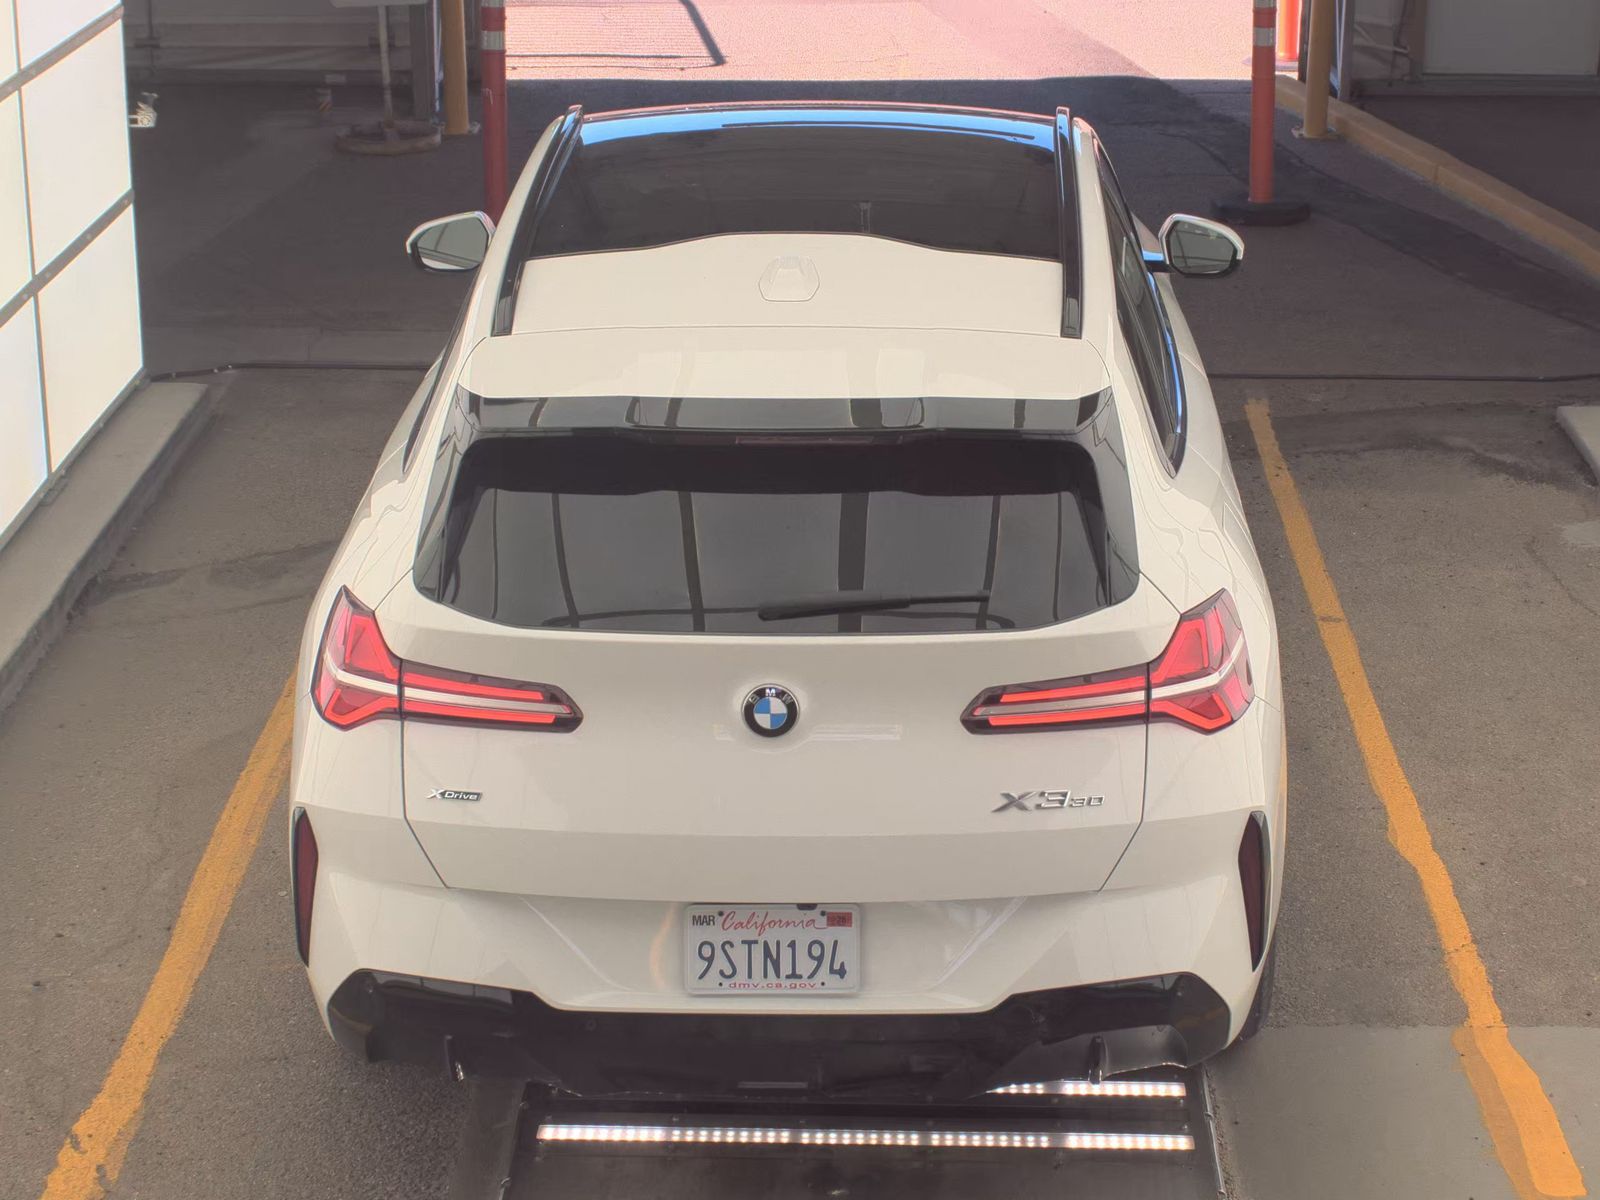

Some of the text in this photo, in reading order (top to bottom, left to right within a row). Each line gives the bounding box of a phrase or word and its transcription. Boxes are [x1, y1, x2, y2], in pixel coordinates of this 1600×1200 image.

[748, 688, 794, 705] BMW
[692, 915, 715, 926] MAR
[721, 911, 828, 936] California
[697, 939, 848, 980] 9STN194
